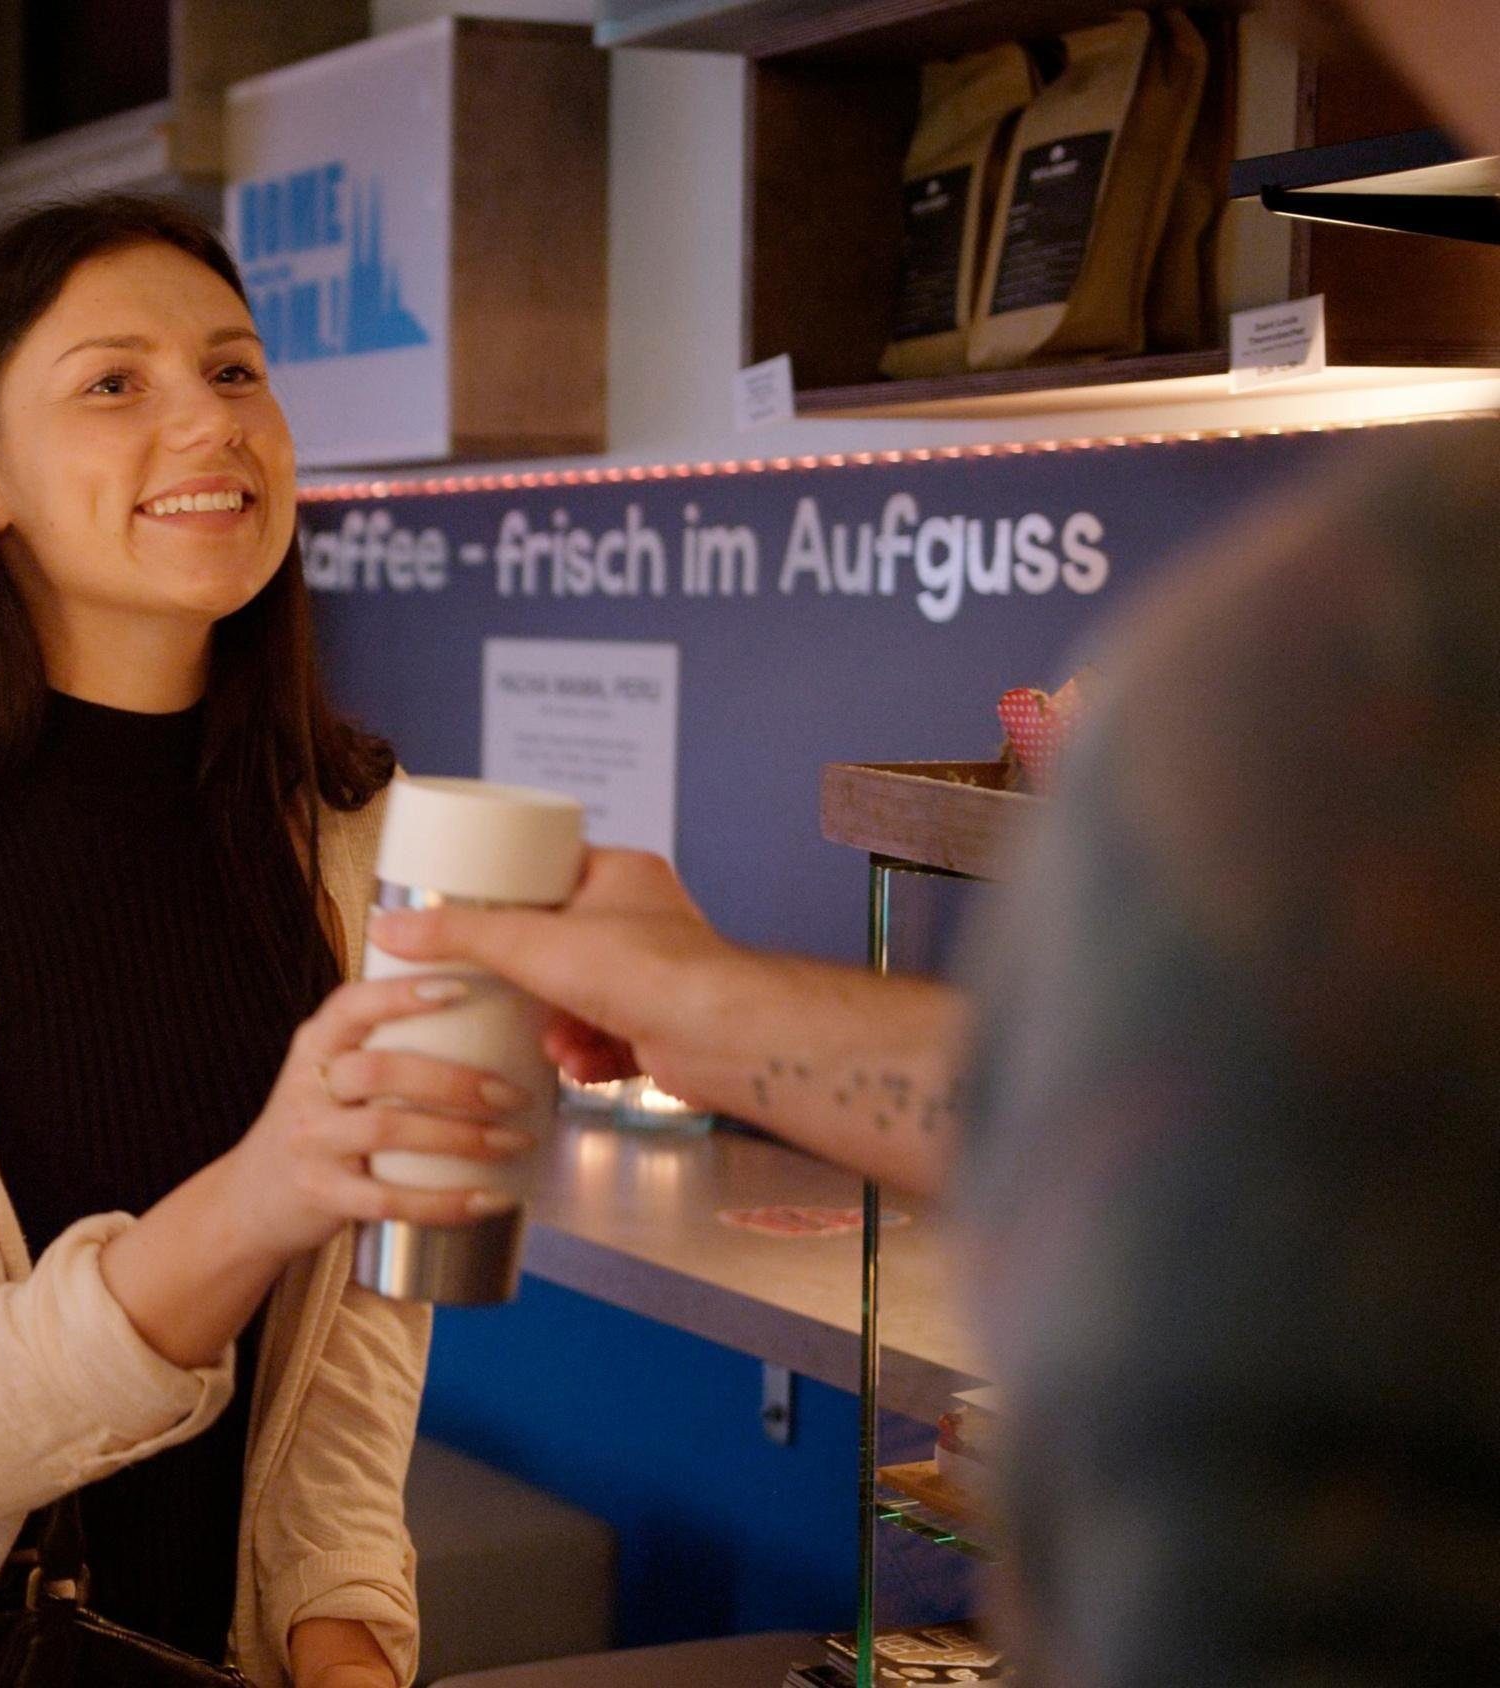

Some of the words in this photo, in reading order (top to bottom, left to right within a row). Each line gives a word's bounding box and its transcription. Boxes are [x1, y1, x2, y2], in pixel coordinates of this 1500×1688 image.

[297, 509, 446, 592] affee
[496, 507, 666, 596] frisch
[683, 503, 757, 596] im
[778, 492, 1109, 623] Aufguss
